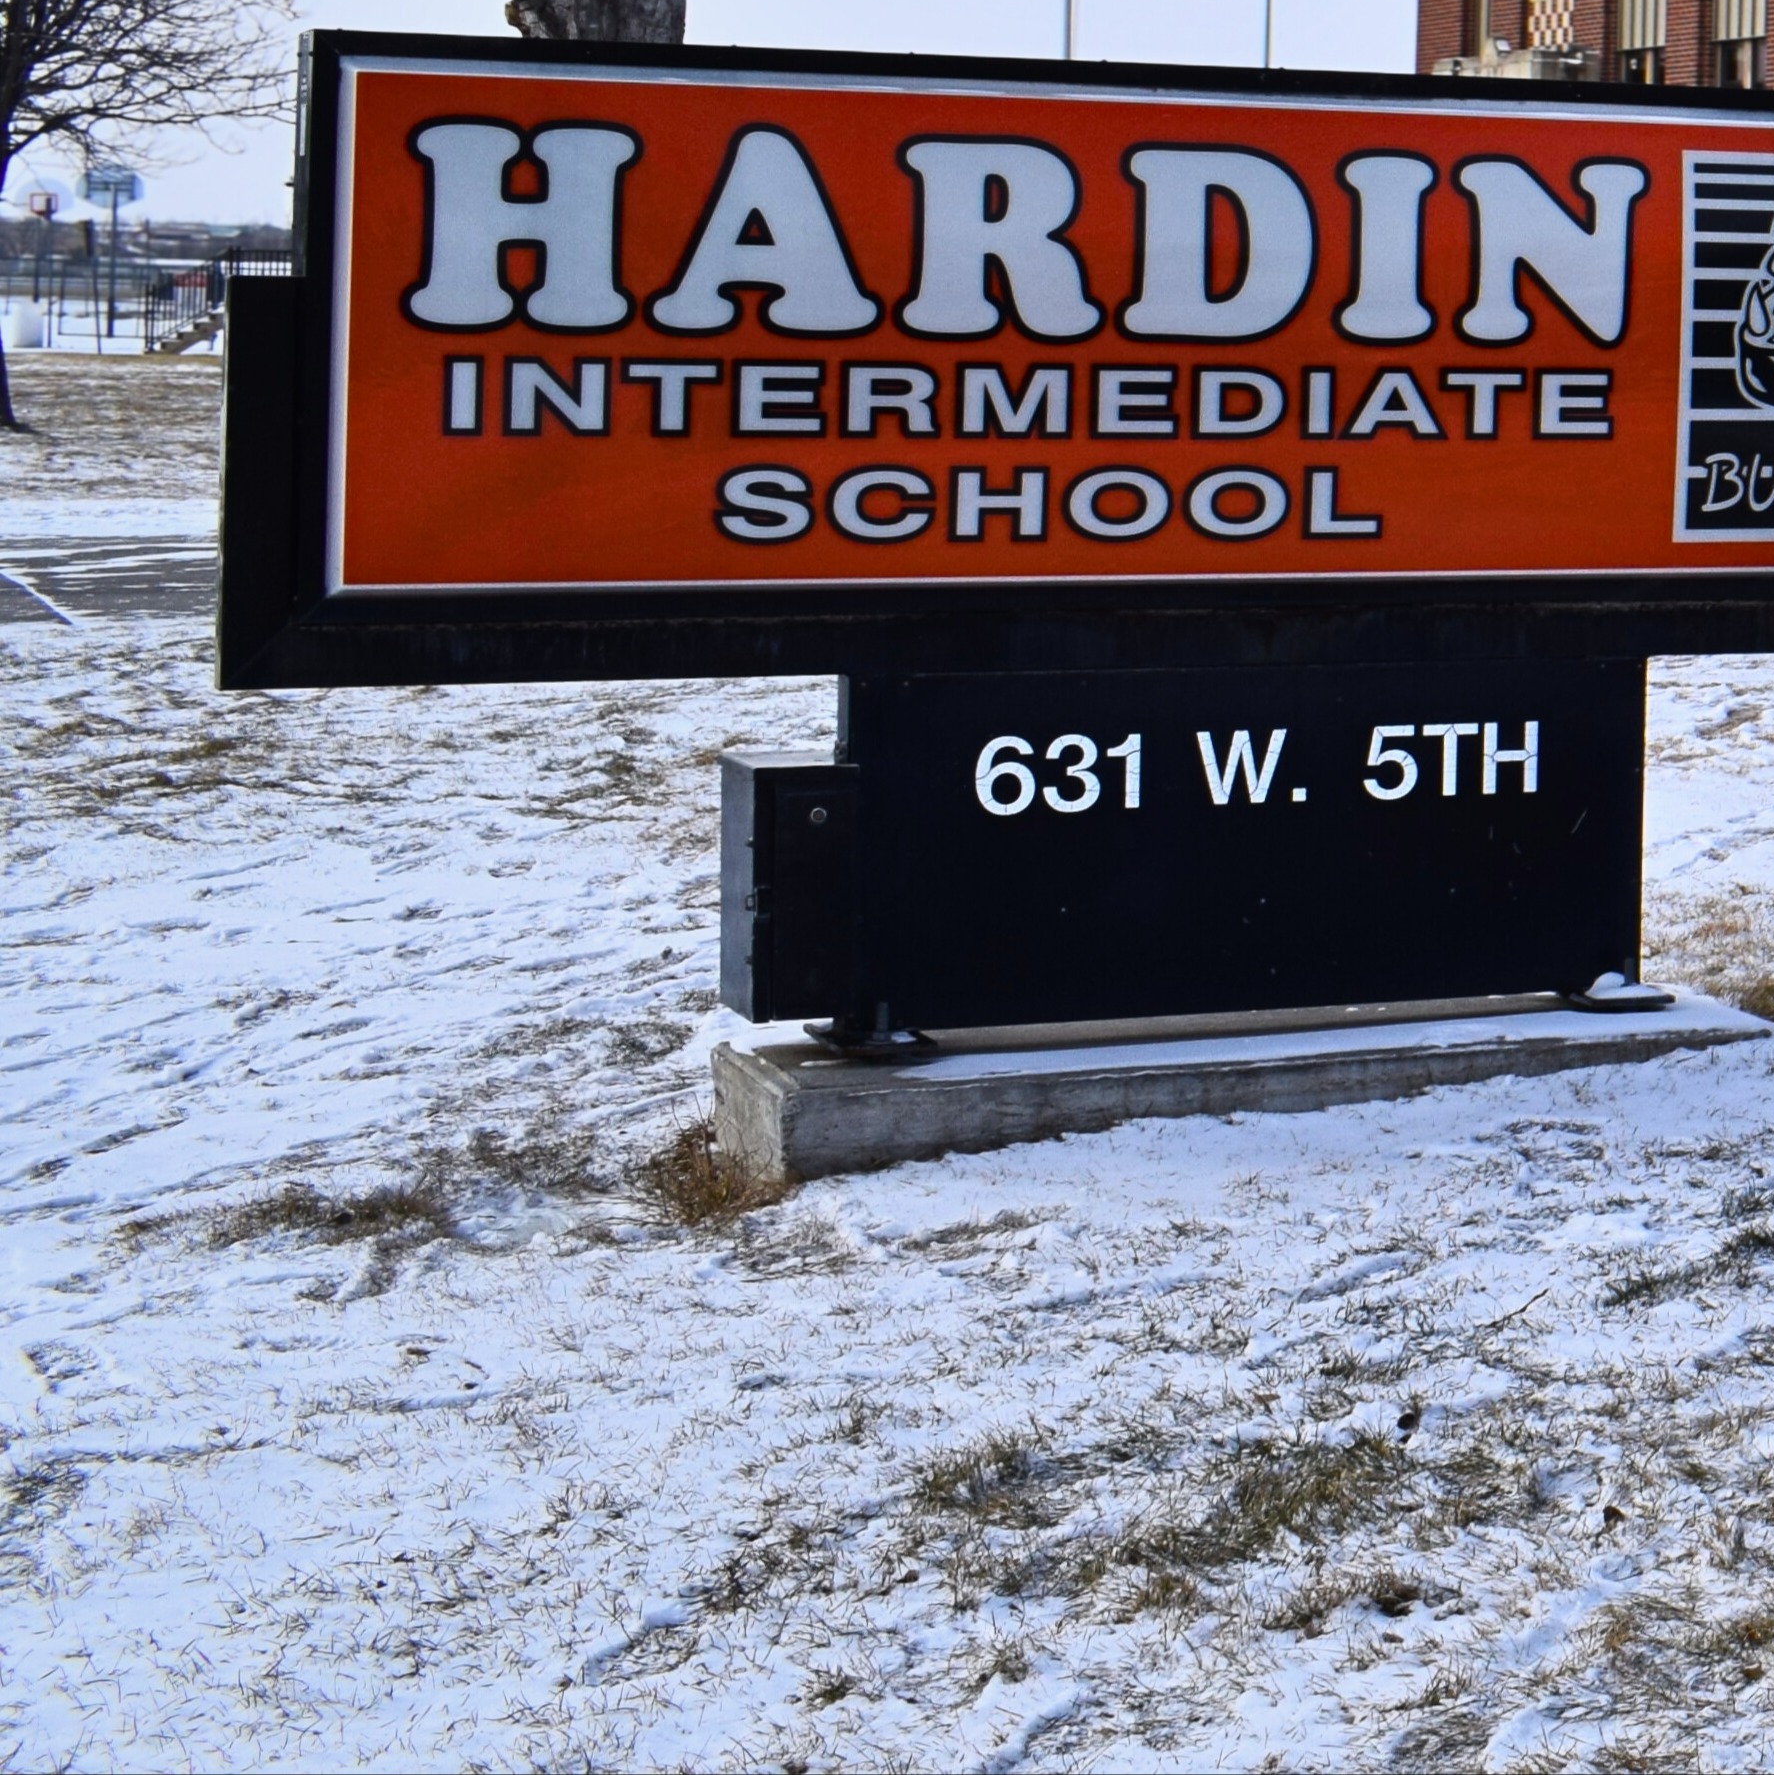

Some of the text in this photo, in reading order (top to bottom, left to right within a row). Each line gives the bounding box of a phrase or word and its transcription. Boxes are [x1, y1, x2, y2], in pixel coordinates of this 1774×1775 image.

[406, 120, 1648, 345] HARDIN
[449, 359, 1610, 436] INTERMEDIATE
[720, 467, 1379, 541] SCHOOL
[975, 720, 1539, 816] 631 W. 5TH
